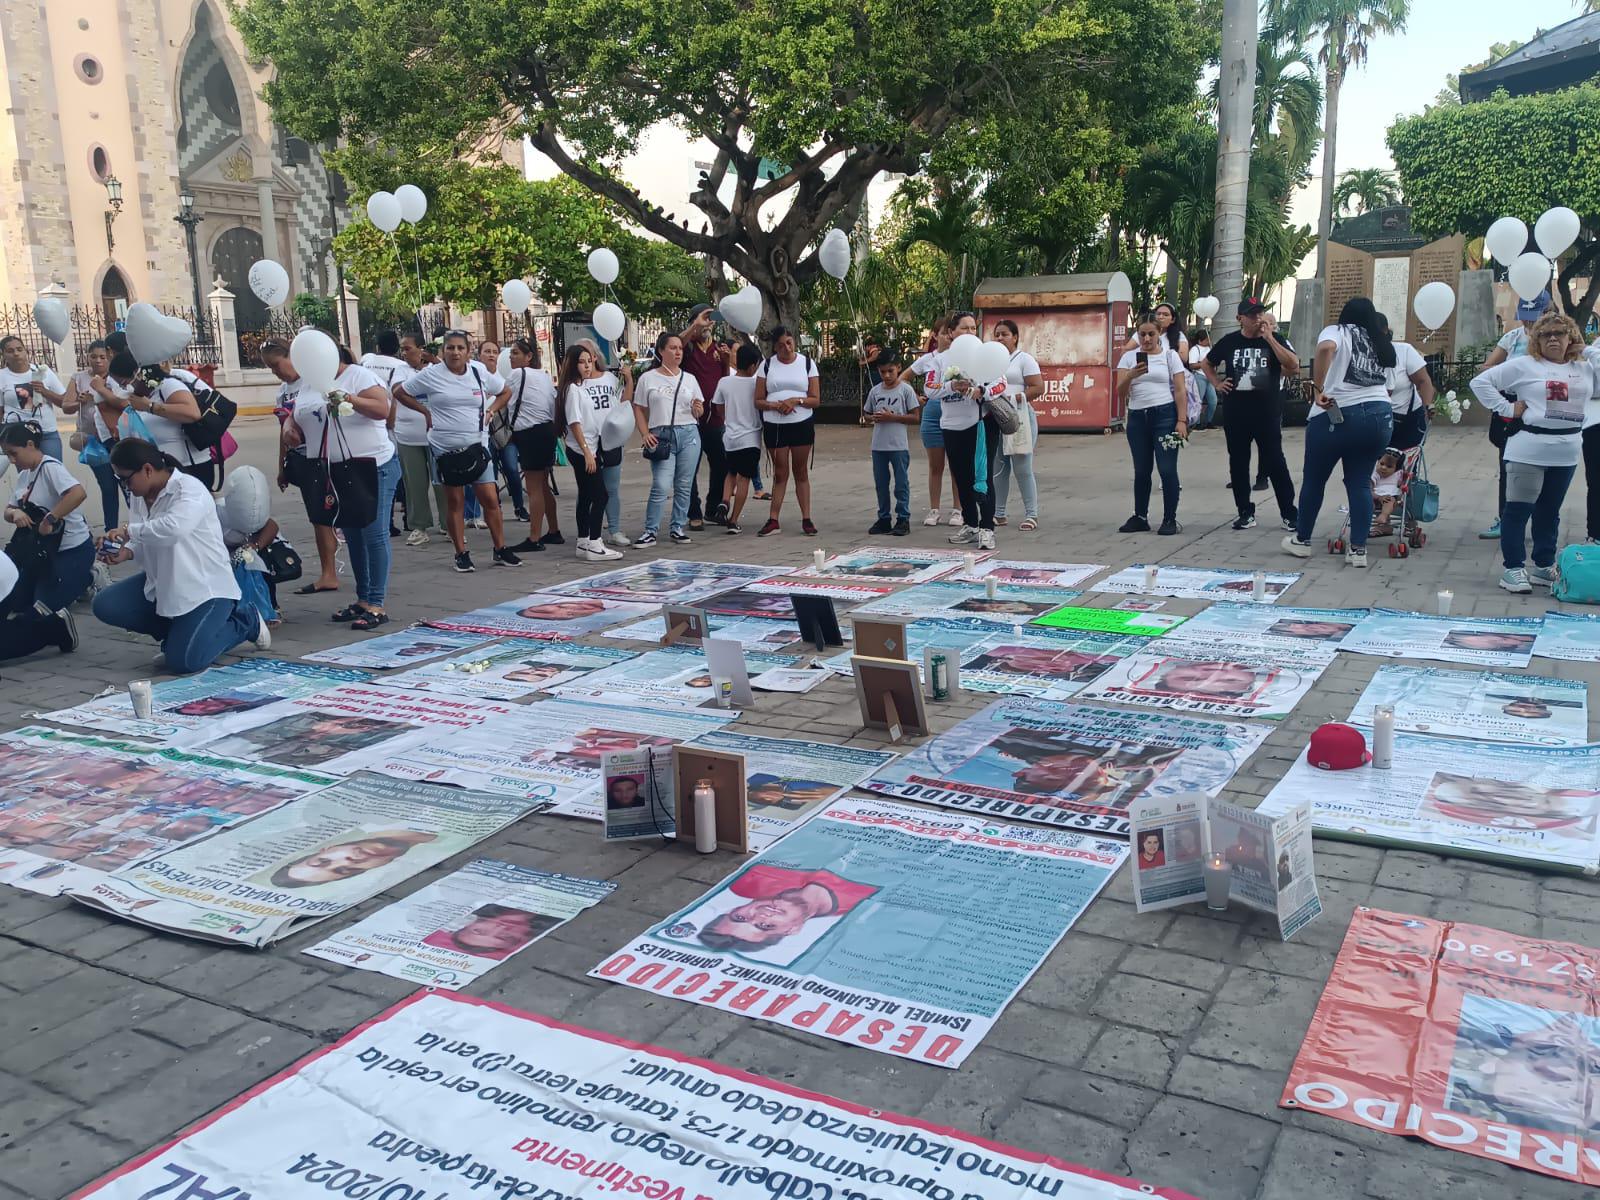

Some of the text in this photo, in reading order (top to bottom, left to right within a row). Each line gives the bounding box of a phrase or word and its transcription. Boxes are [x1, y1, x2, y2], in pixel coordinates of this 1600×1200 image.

[592, 395, 609, 410] 32
[491, 777, 530, 790] Sinaloa
[141, 860, 341, 914] PABLO ISMAEL DÍAZ REYES
[1443, 938, 1533, 968] 1930
[600, 953, 964, 1062] DESAPARECIDO
[634, 943, 973, 1033] ISMAEL ALEJANDRO MARTÍNEZ CARRIZALES
[414, 1032, 441, 1053] la
[442, 1040, 480, 1057] en
[511, 1061, 577, 1092] letra
[355, 1046, 833, 1200] cabello negro, remolino en ceja la
[576, 1081, 679, 1122] tatuaje
[622, 1057, 1064, 1197] mano izquierza dedo anular.
[681, 1109, 748, 1145] 1.73,
[367, 1129, 539, 1200] de la piedra
[511, 1136, 686, 1200] vestimenta
[747, 1133, 955, 1200] aproximada
